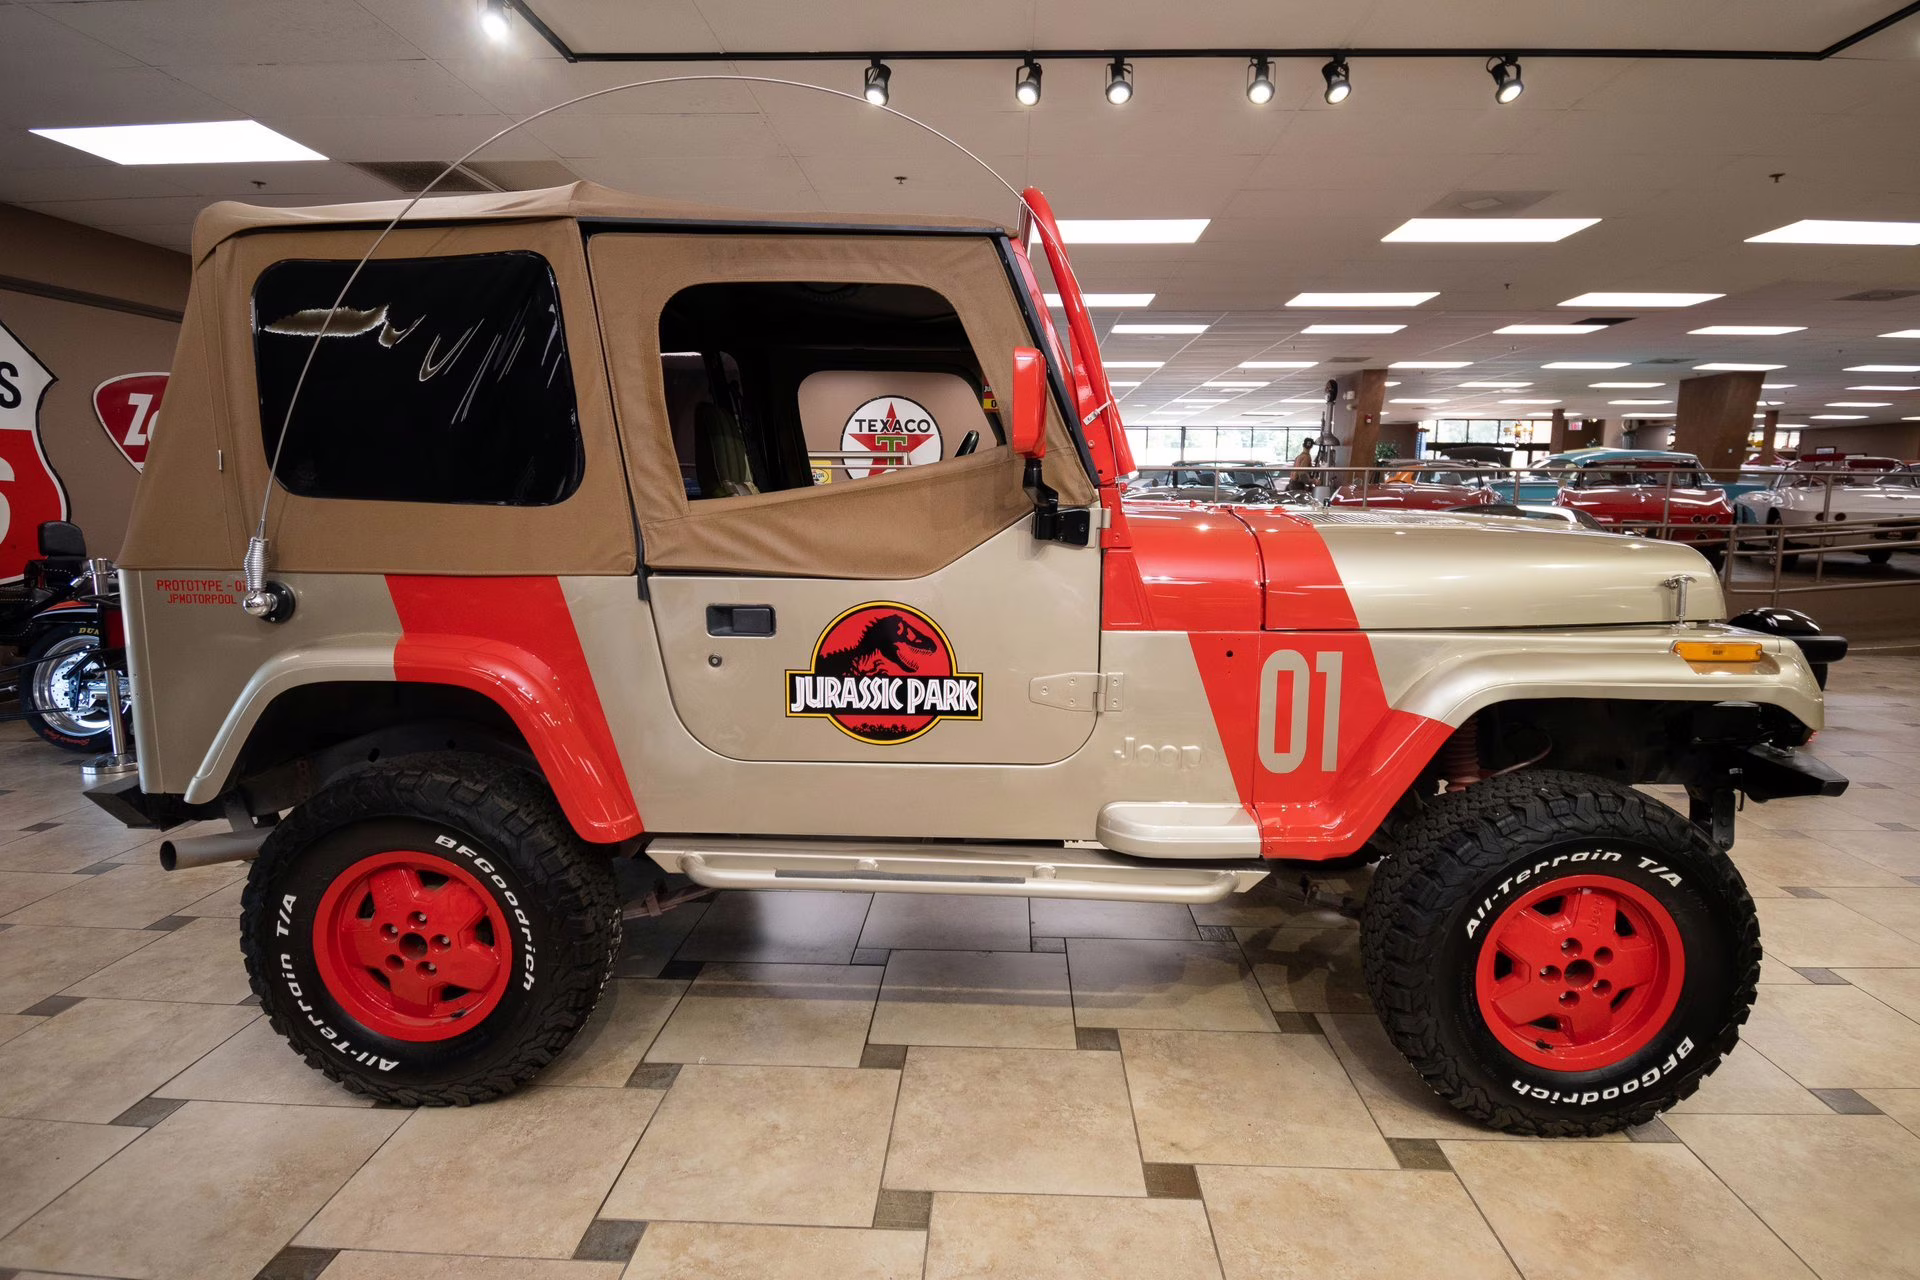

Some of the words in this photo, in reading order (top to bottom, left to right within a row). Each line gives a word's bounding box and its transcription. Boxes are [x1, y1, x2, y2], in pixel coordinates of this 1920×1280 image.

[855, 419, 931, 433] TEXACO
[156, 580, 223, 592] PROTOTYPE
[168, 594, 237, 604] JPMOTORPOOL
[791, 676, 903, 712] JURASSIC
[907, 678, 977, 714] PARK
[1258, 649, 1343, 773] 01
[276, 894, 297, 937] T/A
[435, 835, 535, 991] BFGoodrich
[1466, 849, 1622, 939] All-Terrain
[1637, 856, 1683, 888] T/A
[281, 954, 400, 1072] All-Terrain
[1512, 1036, 1695, 1106] BFGoodrich
